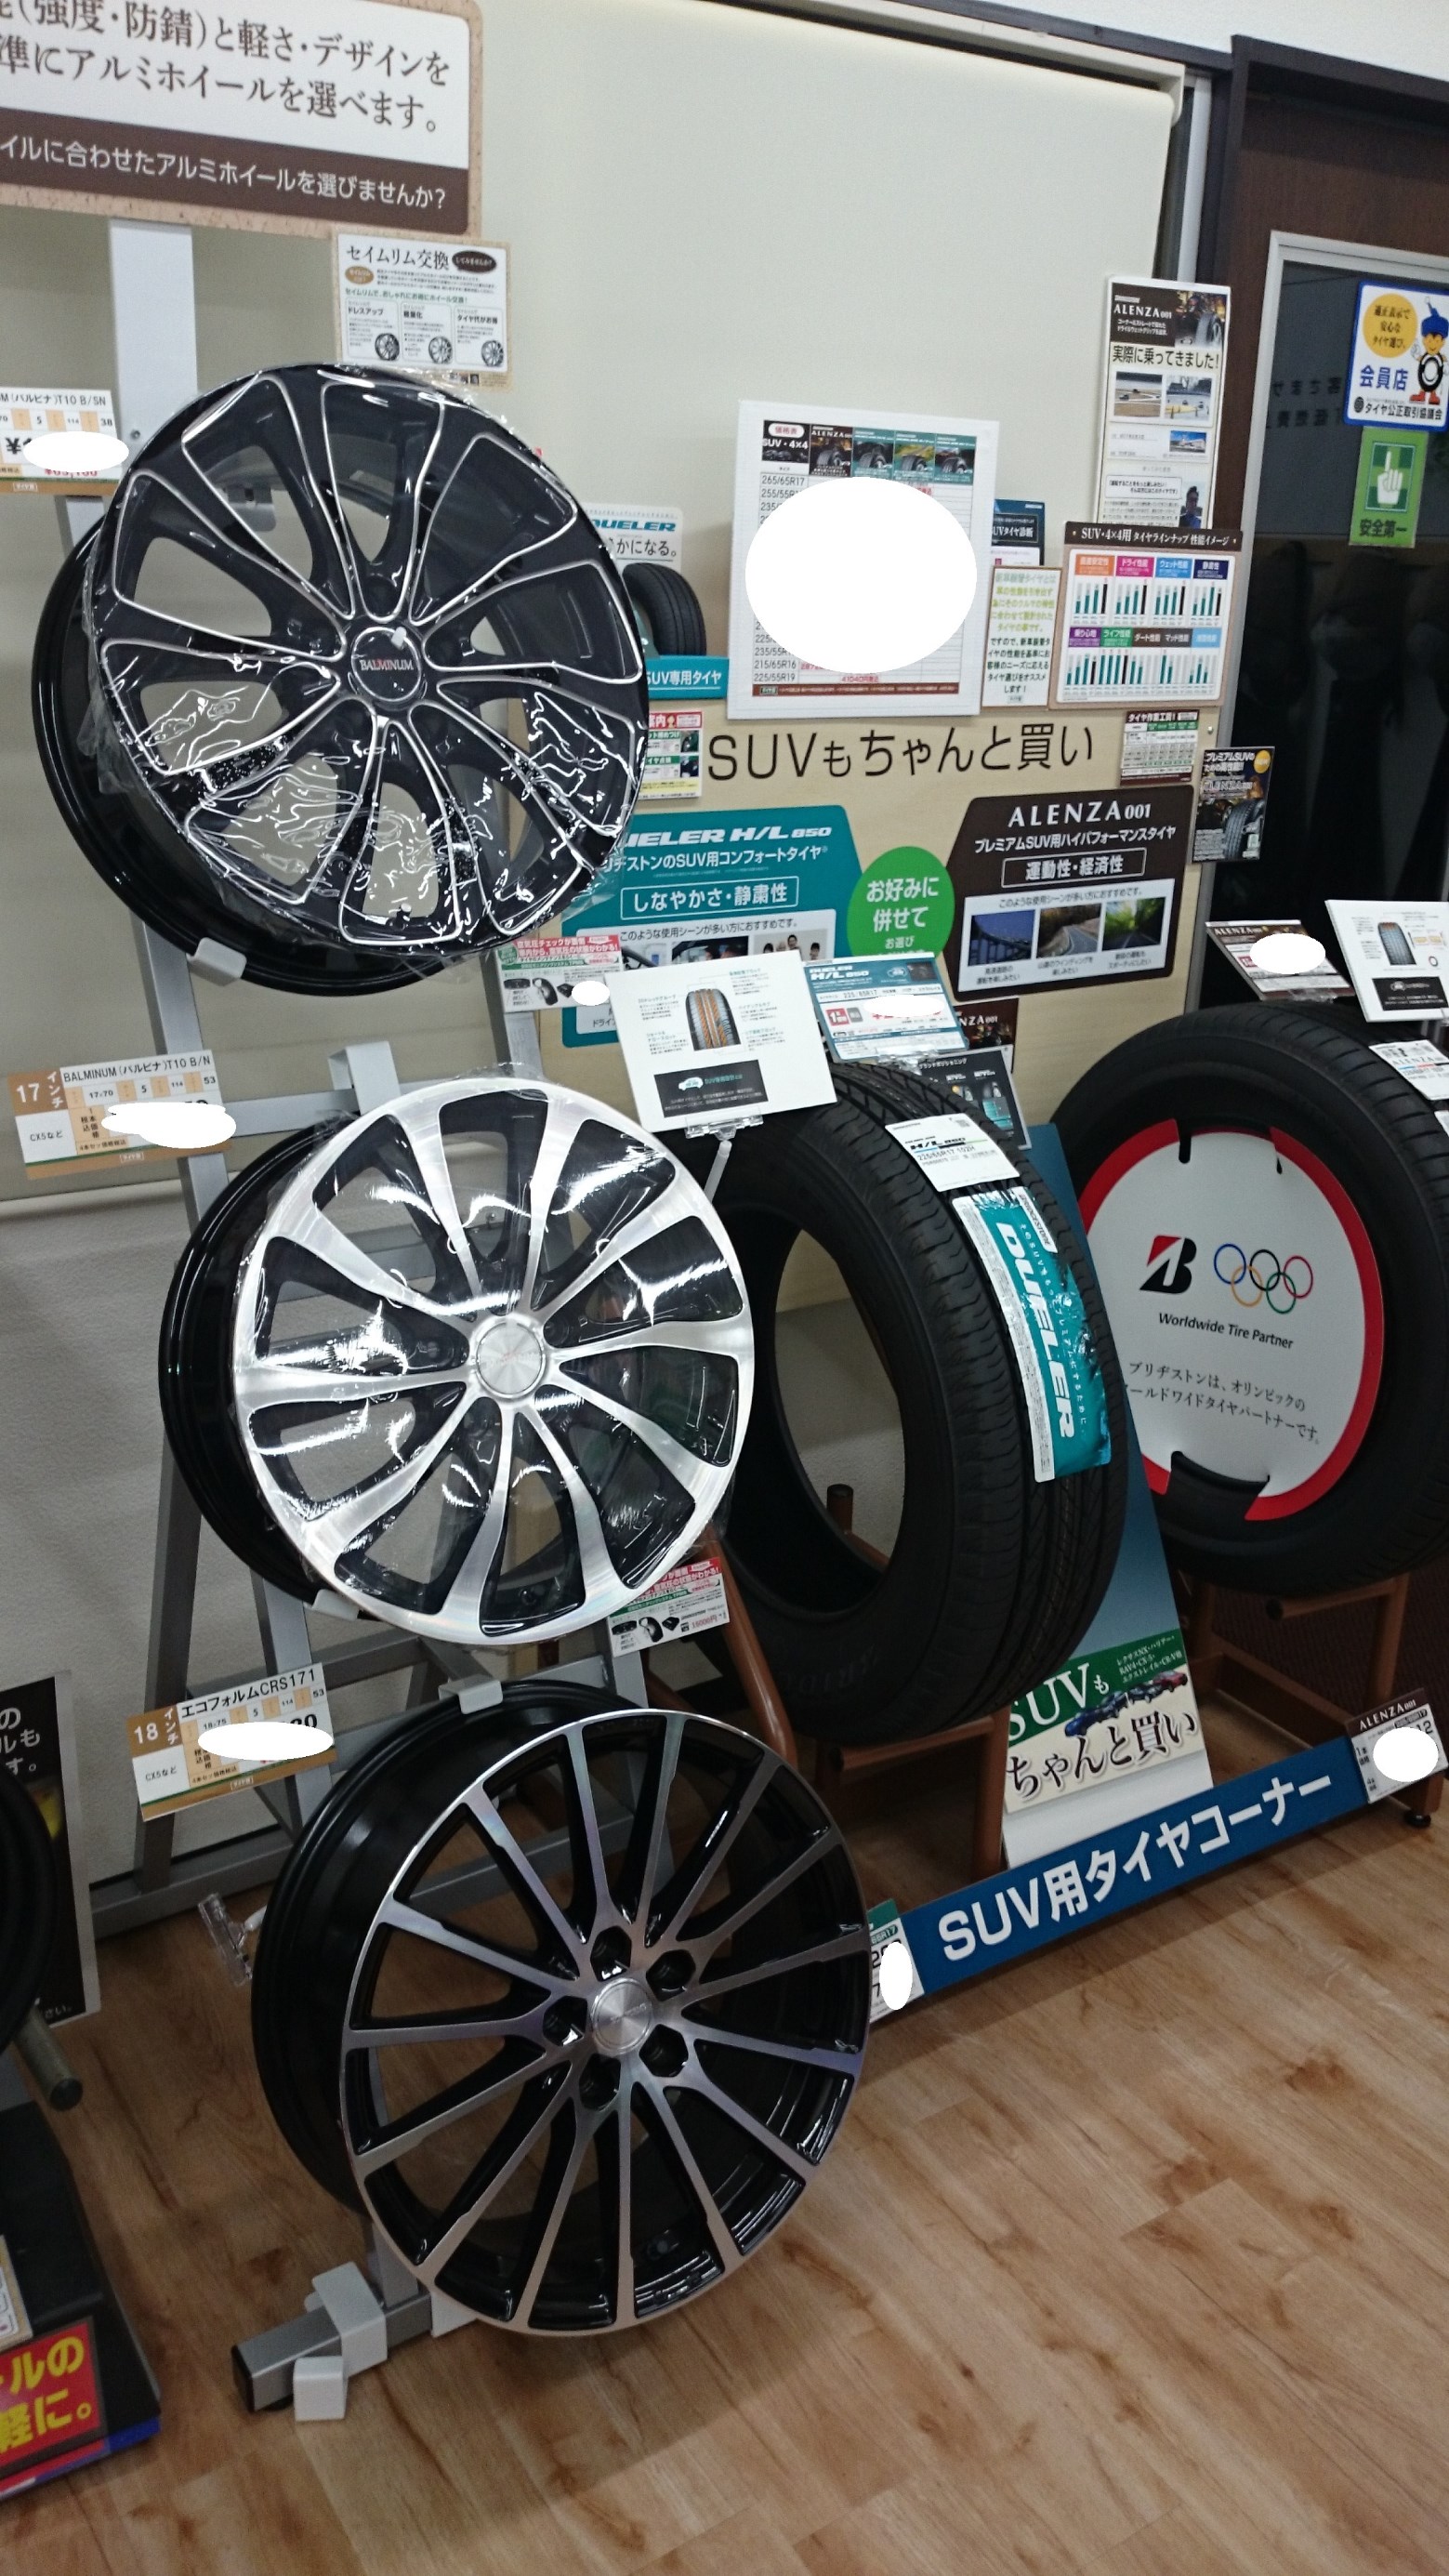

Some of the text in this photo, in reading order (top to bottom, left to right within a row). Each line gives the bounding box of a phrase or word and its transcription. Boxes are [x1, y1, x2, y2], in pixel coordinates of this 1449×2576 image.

[347, 245, 450, 271] セイムリム交換
[1113, 304, 1161, 318] ALENZA
[1113, 345, 1219, 369] 実際に乗ってきました!
[1360, 364, 1409, 391] 会員店
[360, 659, 415, 671] BALMINUM
[708, 723, 1092, 781] SUVもちゃんと買い
[1008, 800, 1152, 827] ALENZA 001
[975, 826, 1177, 853] プレミアムSUV用ハイパフォーマンスタイヤ
[1025, 854, 1125, 881] 運動性・経済性
[633, 883, 787, 913] しなやかさ・静粛性
[867, 876, 940, 903] お好みに
[620, 918, 797, 941] このような使用シーンが多い方におすすめです。
[873, 907, 927, 932] 併せて
[885, 936, 915, 949] お選び
[17, 1083, 40, 1103] 17
[46, 1072, 64, 1109] インチ
[996, 1222, 1075, 1439] DUELER
[1158, 1312, 1294, 1350] Worldwide Tire Partner
[1129, 1362, 1306, 1413] ブリヂストンは、オリンピックの
[1124, 1383, 1320, 1445] ールドワイドタイヤパートナーです。
[181, 1669, 315, 1719] エコフォルムCRS171
[164, 1707, 178, 1746] インチ
[1360, 1702, 1404, 1732] ALENZA
[134, 1722, 159, 1745] 18
[1007, 1711, 1195, 1798] ちゃんと買い
[937, 1774, 1333, 1962] SUV用タイヤコーナー
[0, 2335, 86, 2395] ルの
